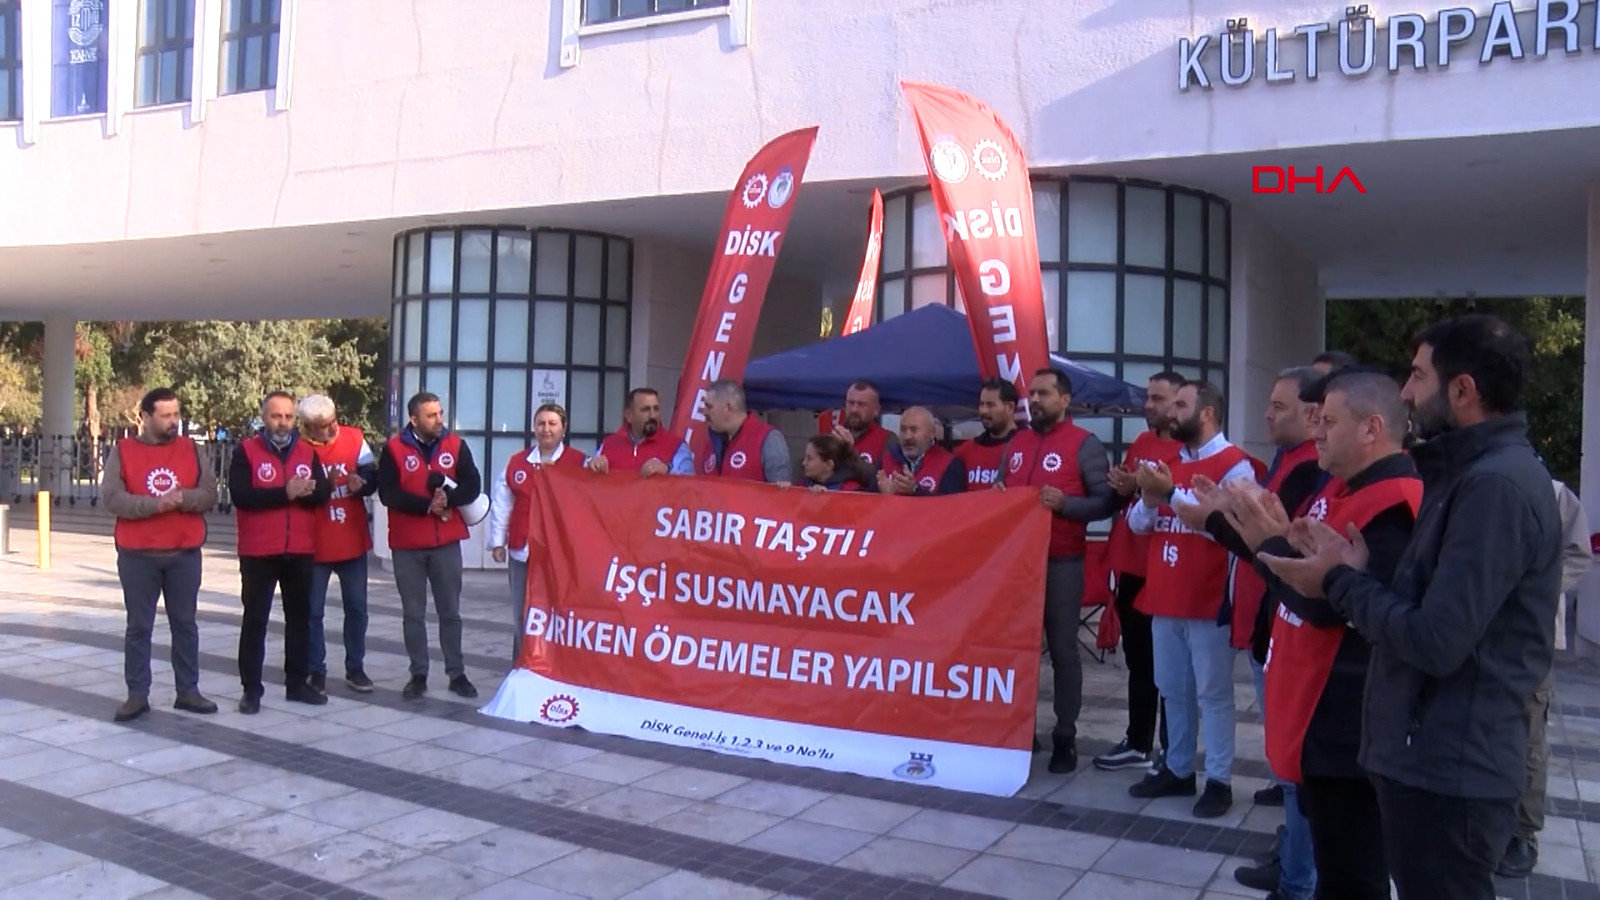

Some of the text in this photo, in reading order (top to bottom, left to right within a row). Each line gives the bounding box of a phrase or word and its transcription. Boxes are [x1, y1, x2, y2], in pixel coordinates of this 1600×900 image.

[724, 224, 781, 257] DİSK
[655, 507, 745, 546] SABIR
[754, 517, 855, 561] TAŞTI
[1163, 540, 1179, 567] İŞ
[605, 556, 915, 626] İŞÇİ SUSMAYACAK
[525, 606, 1015, 704] BİRİKEN ÖDEMELER YAPILSIN
[549, 703, 571, 716] DİSK
[640, 719, 673, 734] DİSK
[766, 743, 782, 752] ve
[785, 744, 795, 754] 9
[796, 745, 834, 759] No'lu
